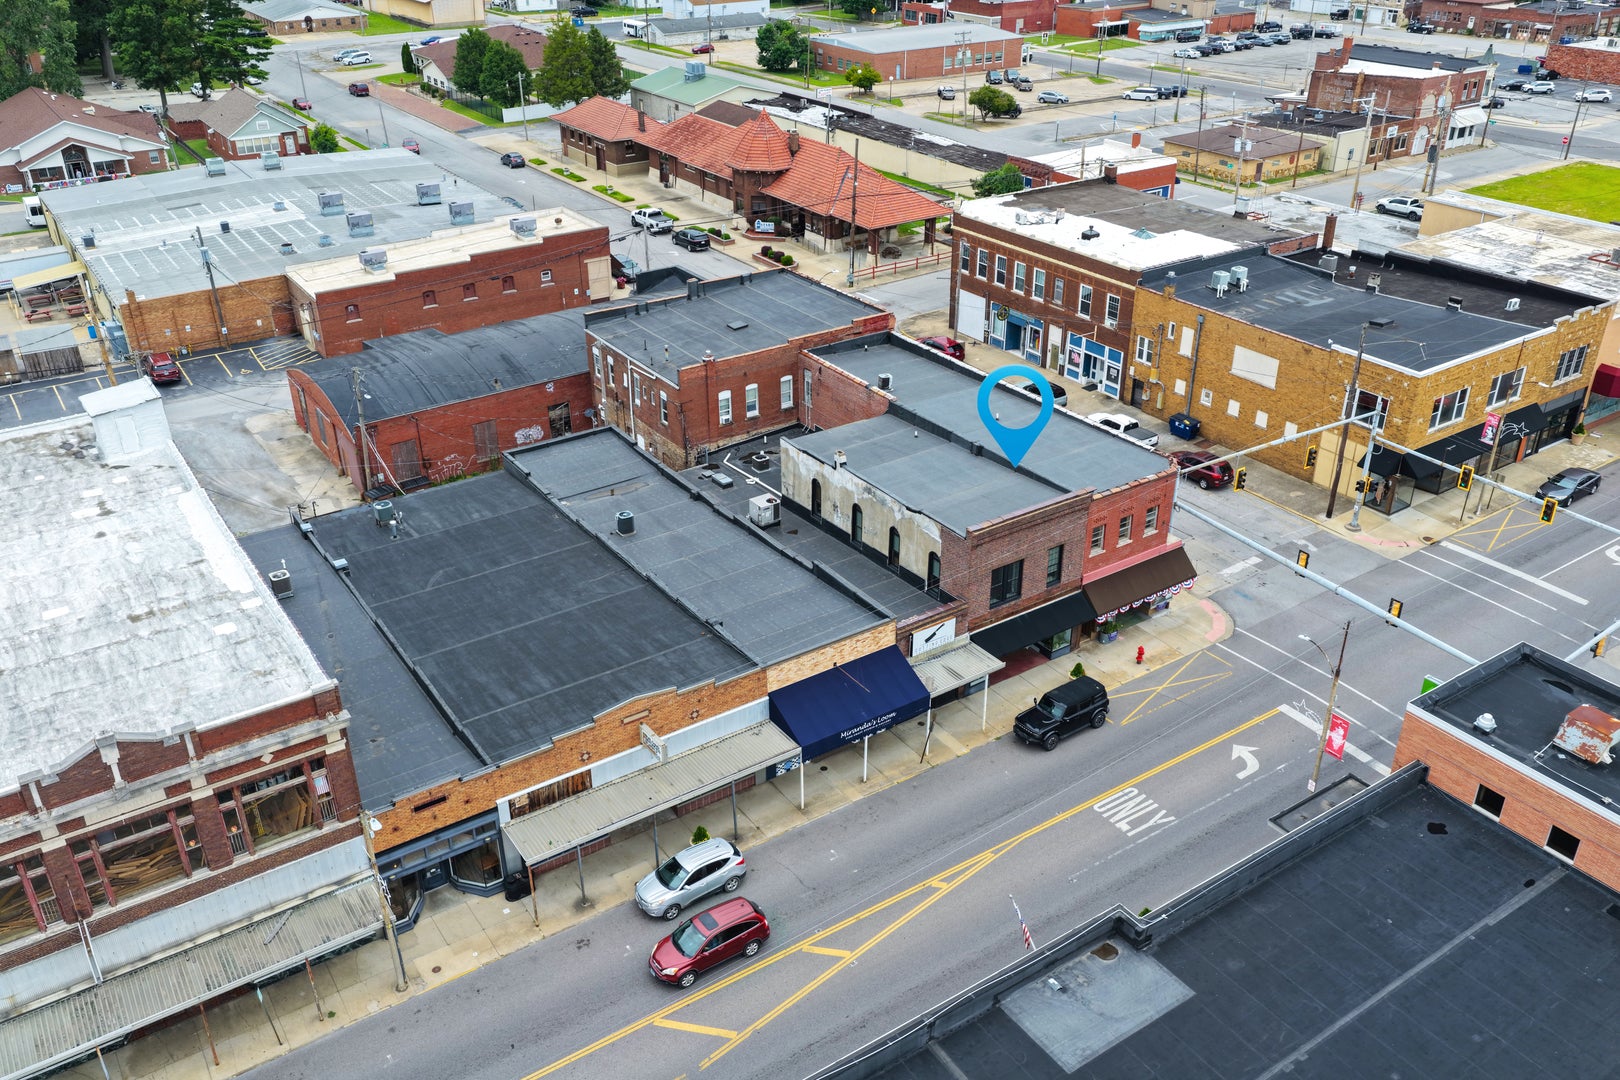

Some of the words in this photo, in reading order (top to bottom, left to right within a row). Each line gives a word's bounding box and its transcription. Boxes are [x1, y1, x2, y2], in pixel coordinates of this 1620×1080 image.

[840, 719, 877, 739] Miranda's
[877, 711, 897, 724] Loom
[1093, 787, 1176, 837] ONLY
